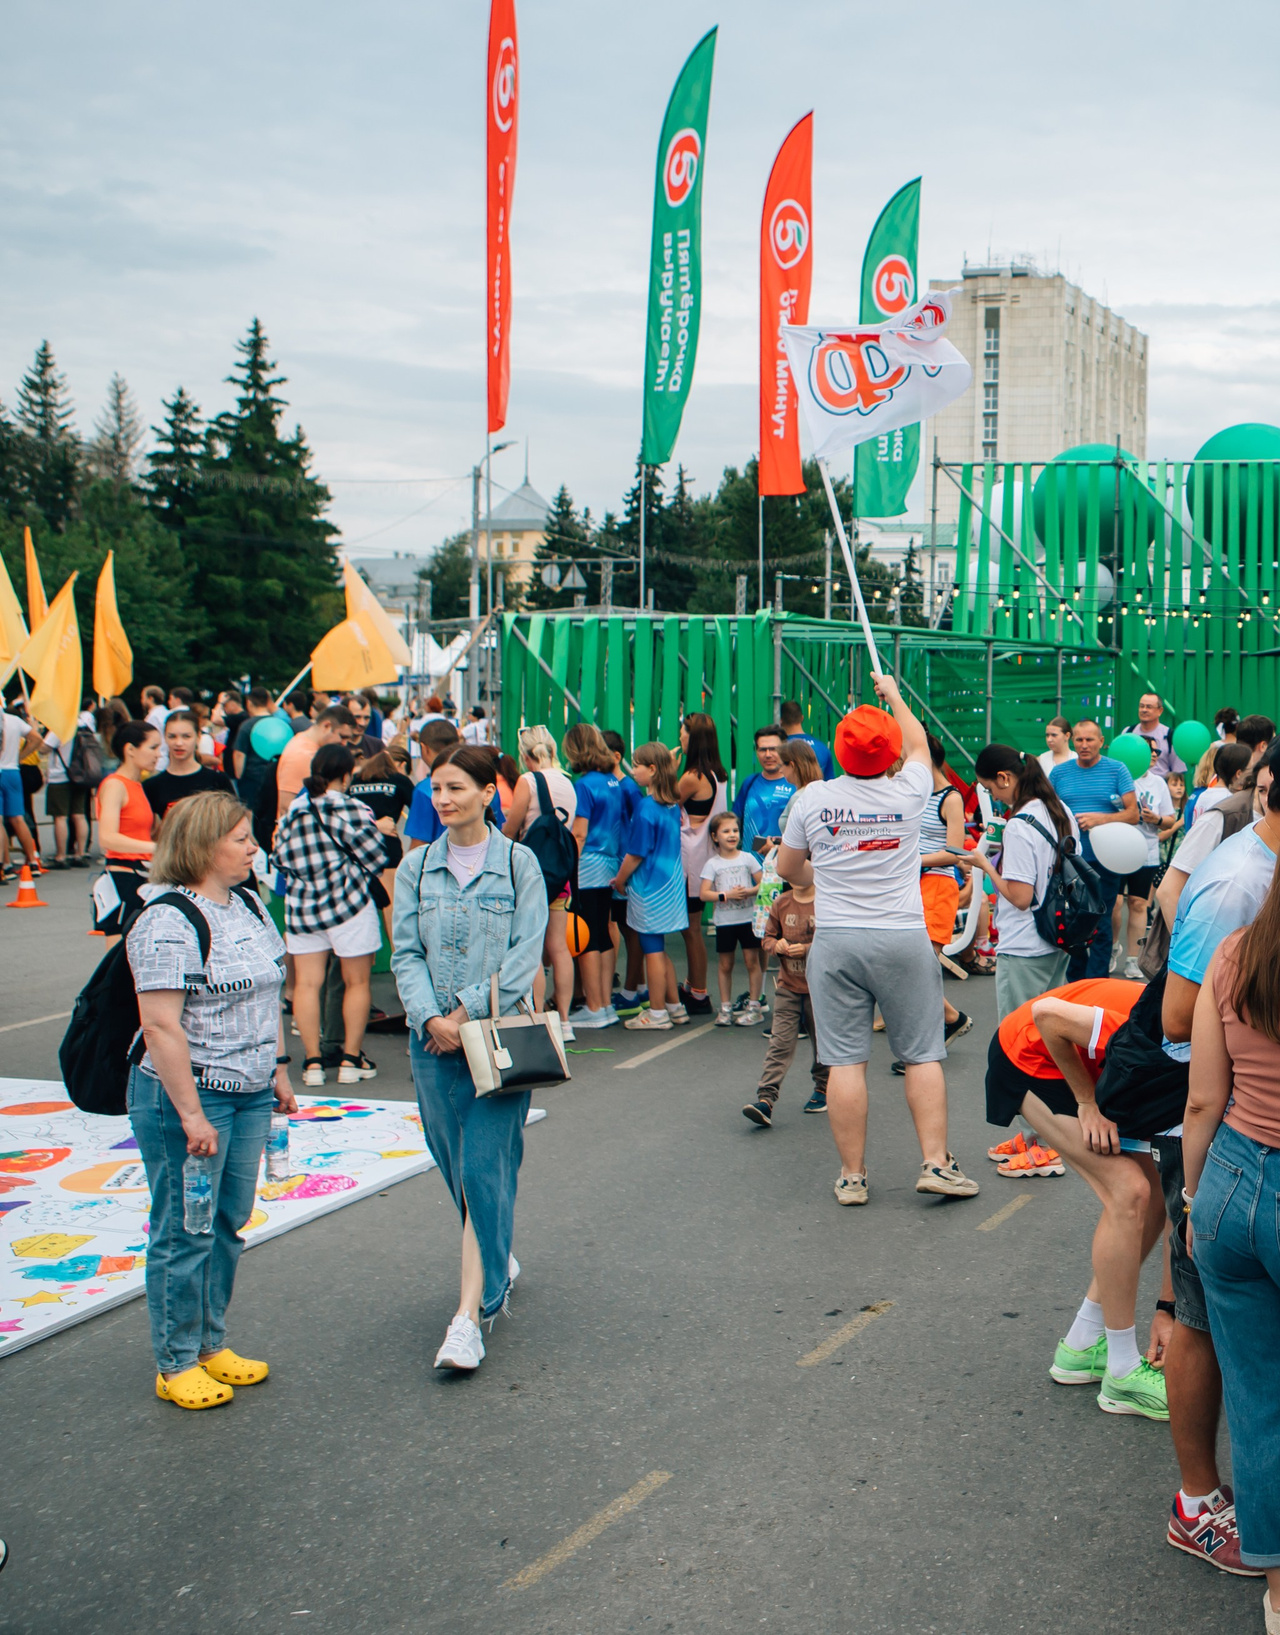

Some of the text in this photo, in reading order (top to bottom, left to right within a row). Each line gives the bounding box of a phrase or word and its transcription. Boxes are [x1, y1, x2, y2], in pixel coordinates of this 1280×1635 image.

[669, 150, 698, 188] 5
[775, 219, 803, 251] 5
[880, 272, 911, 301] 5
[654, 232, 674, 392] выручает!
[668, 229, 694, 393] Пятёрочка
[820, 807, 856, 823] ФИЛ
[205, 978, 253, 995] MOOD
[199, 1077, 242, 1092] MOOD
[1195, 1526, 1228, 1557] N
